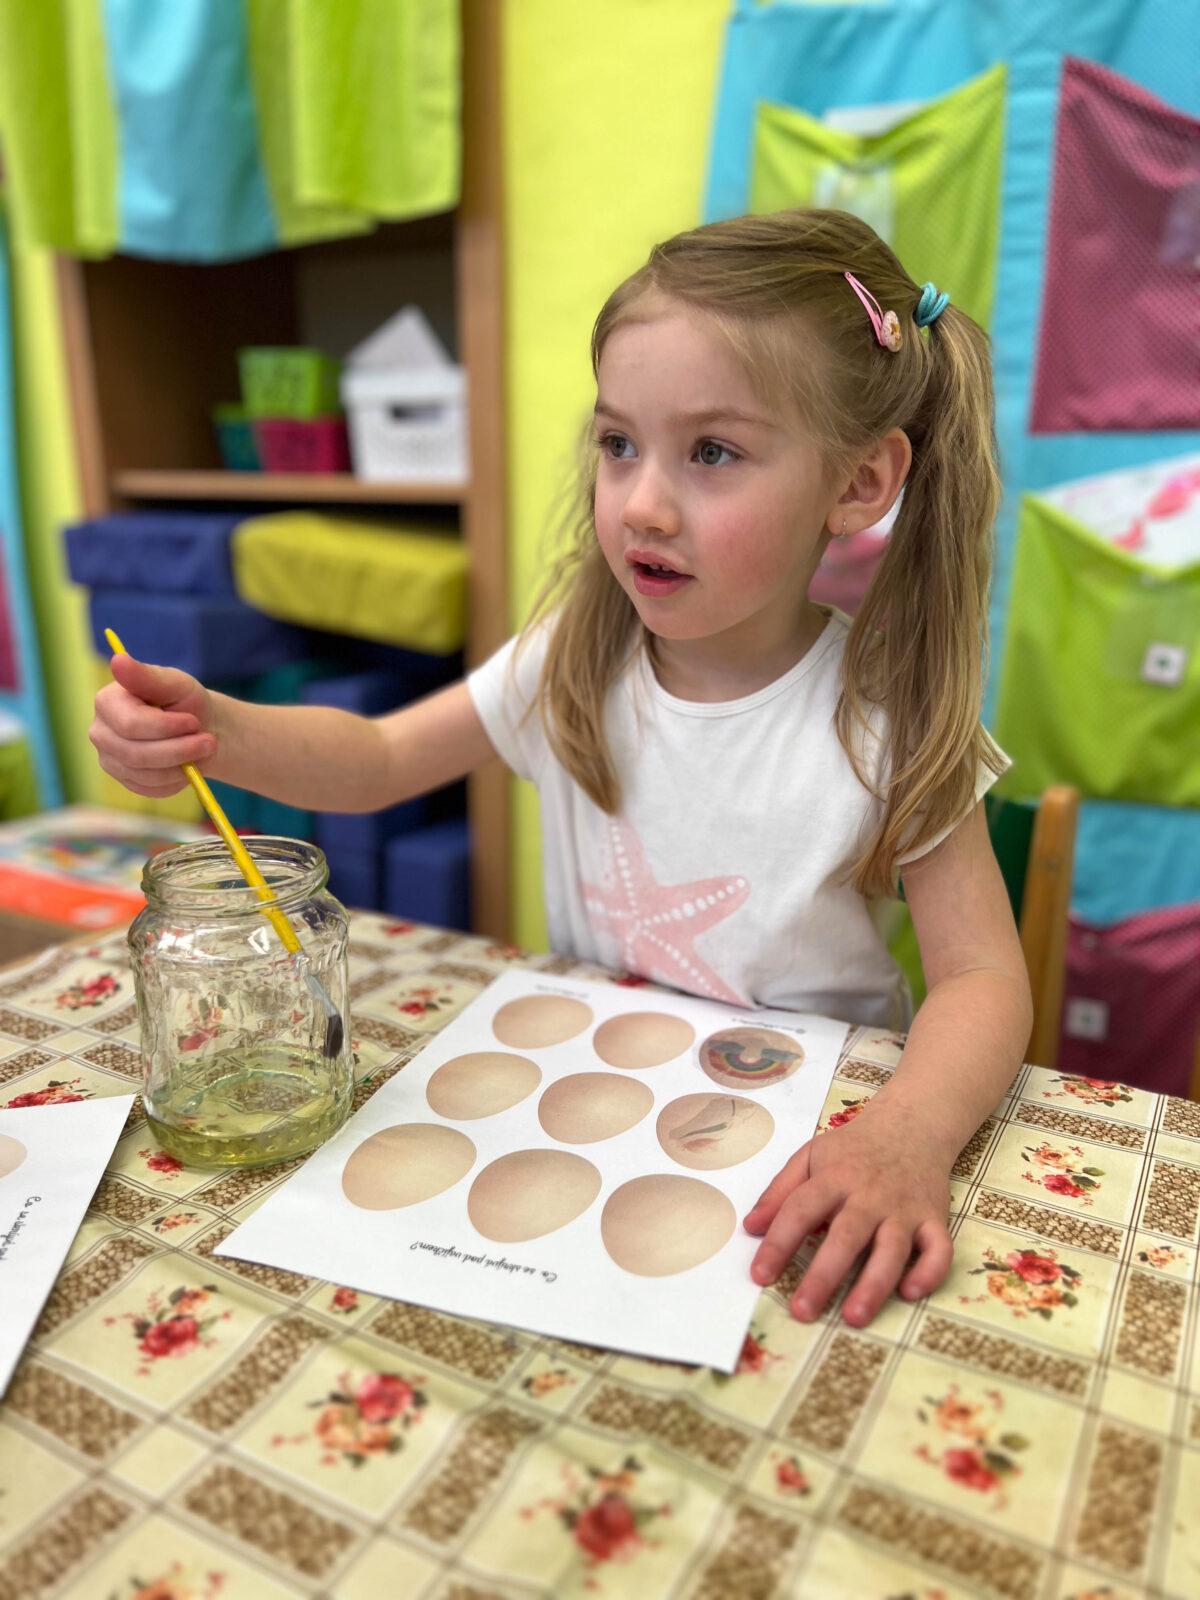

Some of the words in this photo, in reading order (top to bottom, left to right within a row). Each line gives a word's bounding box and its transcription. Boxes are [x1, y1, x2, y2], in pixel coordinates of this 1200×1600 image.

[25, 1196, 42, 1208] Co
[409, 1240, 462, 1258] vajíčkem?
[462, 1254, 486, 1264] pod
[485, 1257, 522, 1273] skrývá
[523, 1266, 536, 1275] se
[541, 1270, 558, 1283] Co
